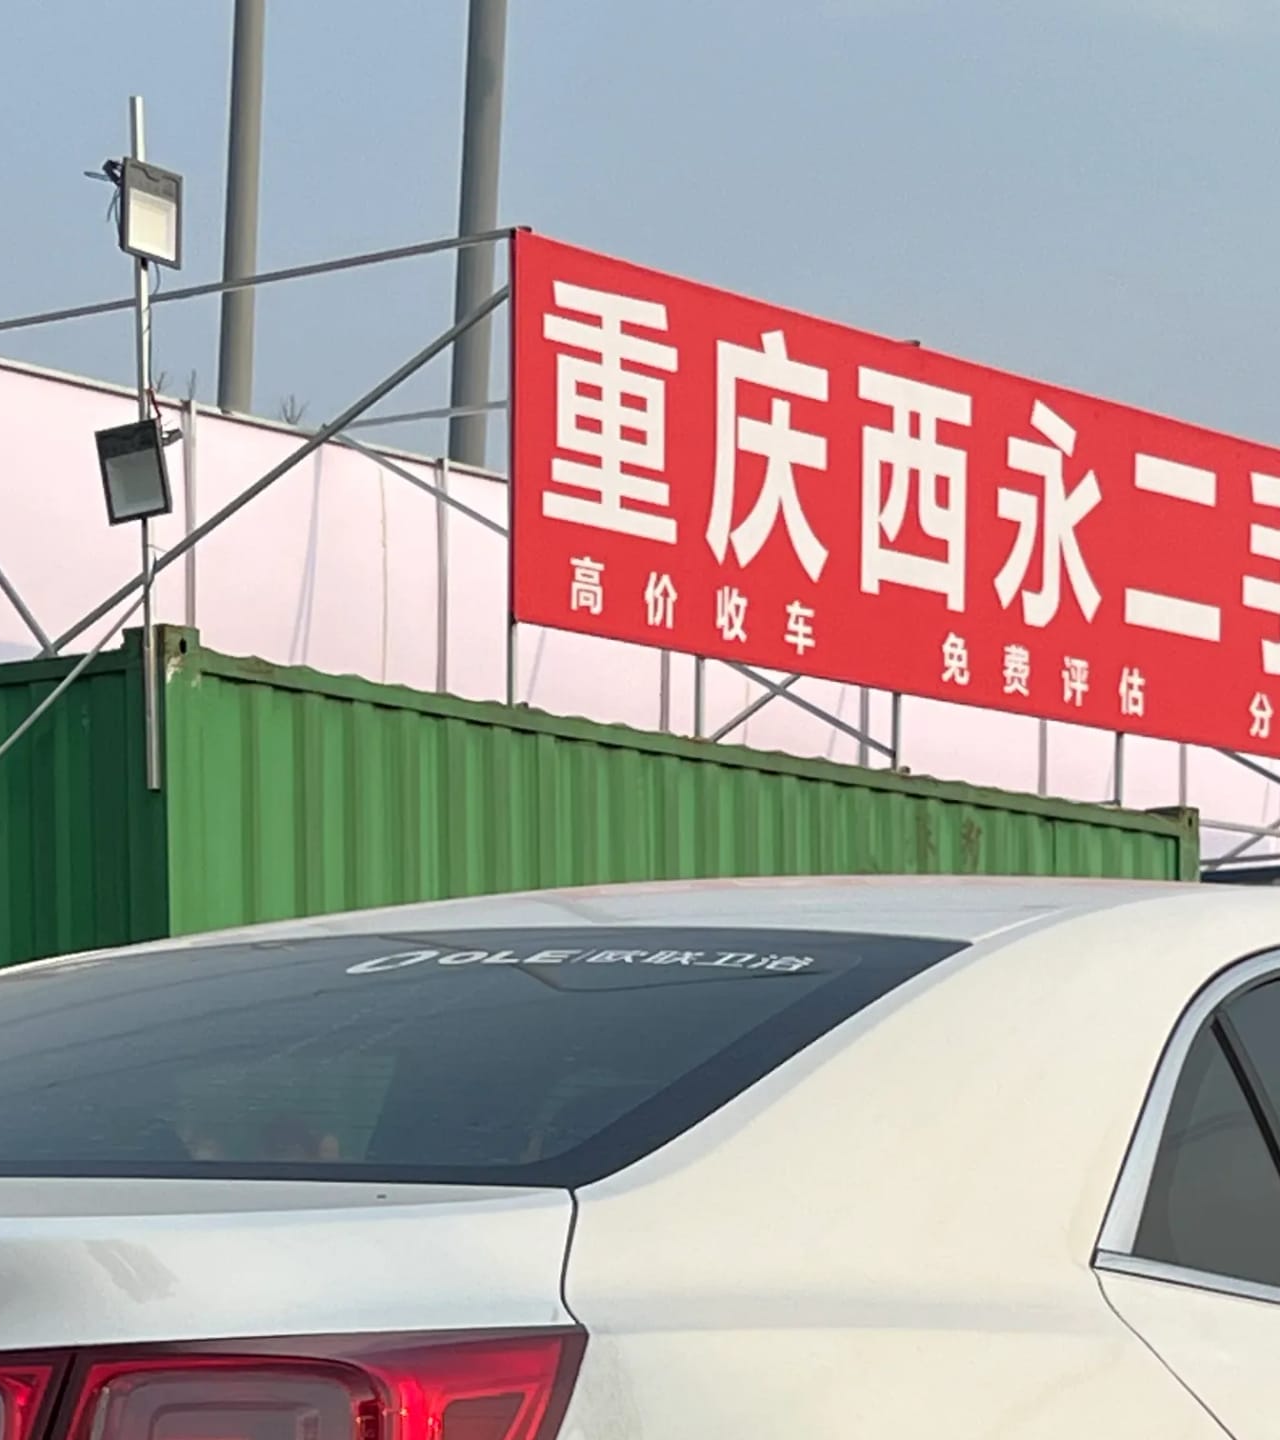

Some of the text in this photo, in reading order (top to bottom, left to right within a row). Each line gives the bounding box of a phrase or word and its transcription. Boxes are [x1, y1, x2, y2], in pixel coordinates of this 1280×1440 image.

[570, 556, 816, 655] 高价收车
[941, 632, 1146, 717] 免费评估
